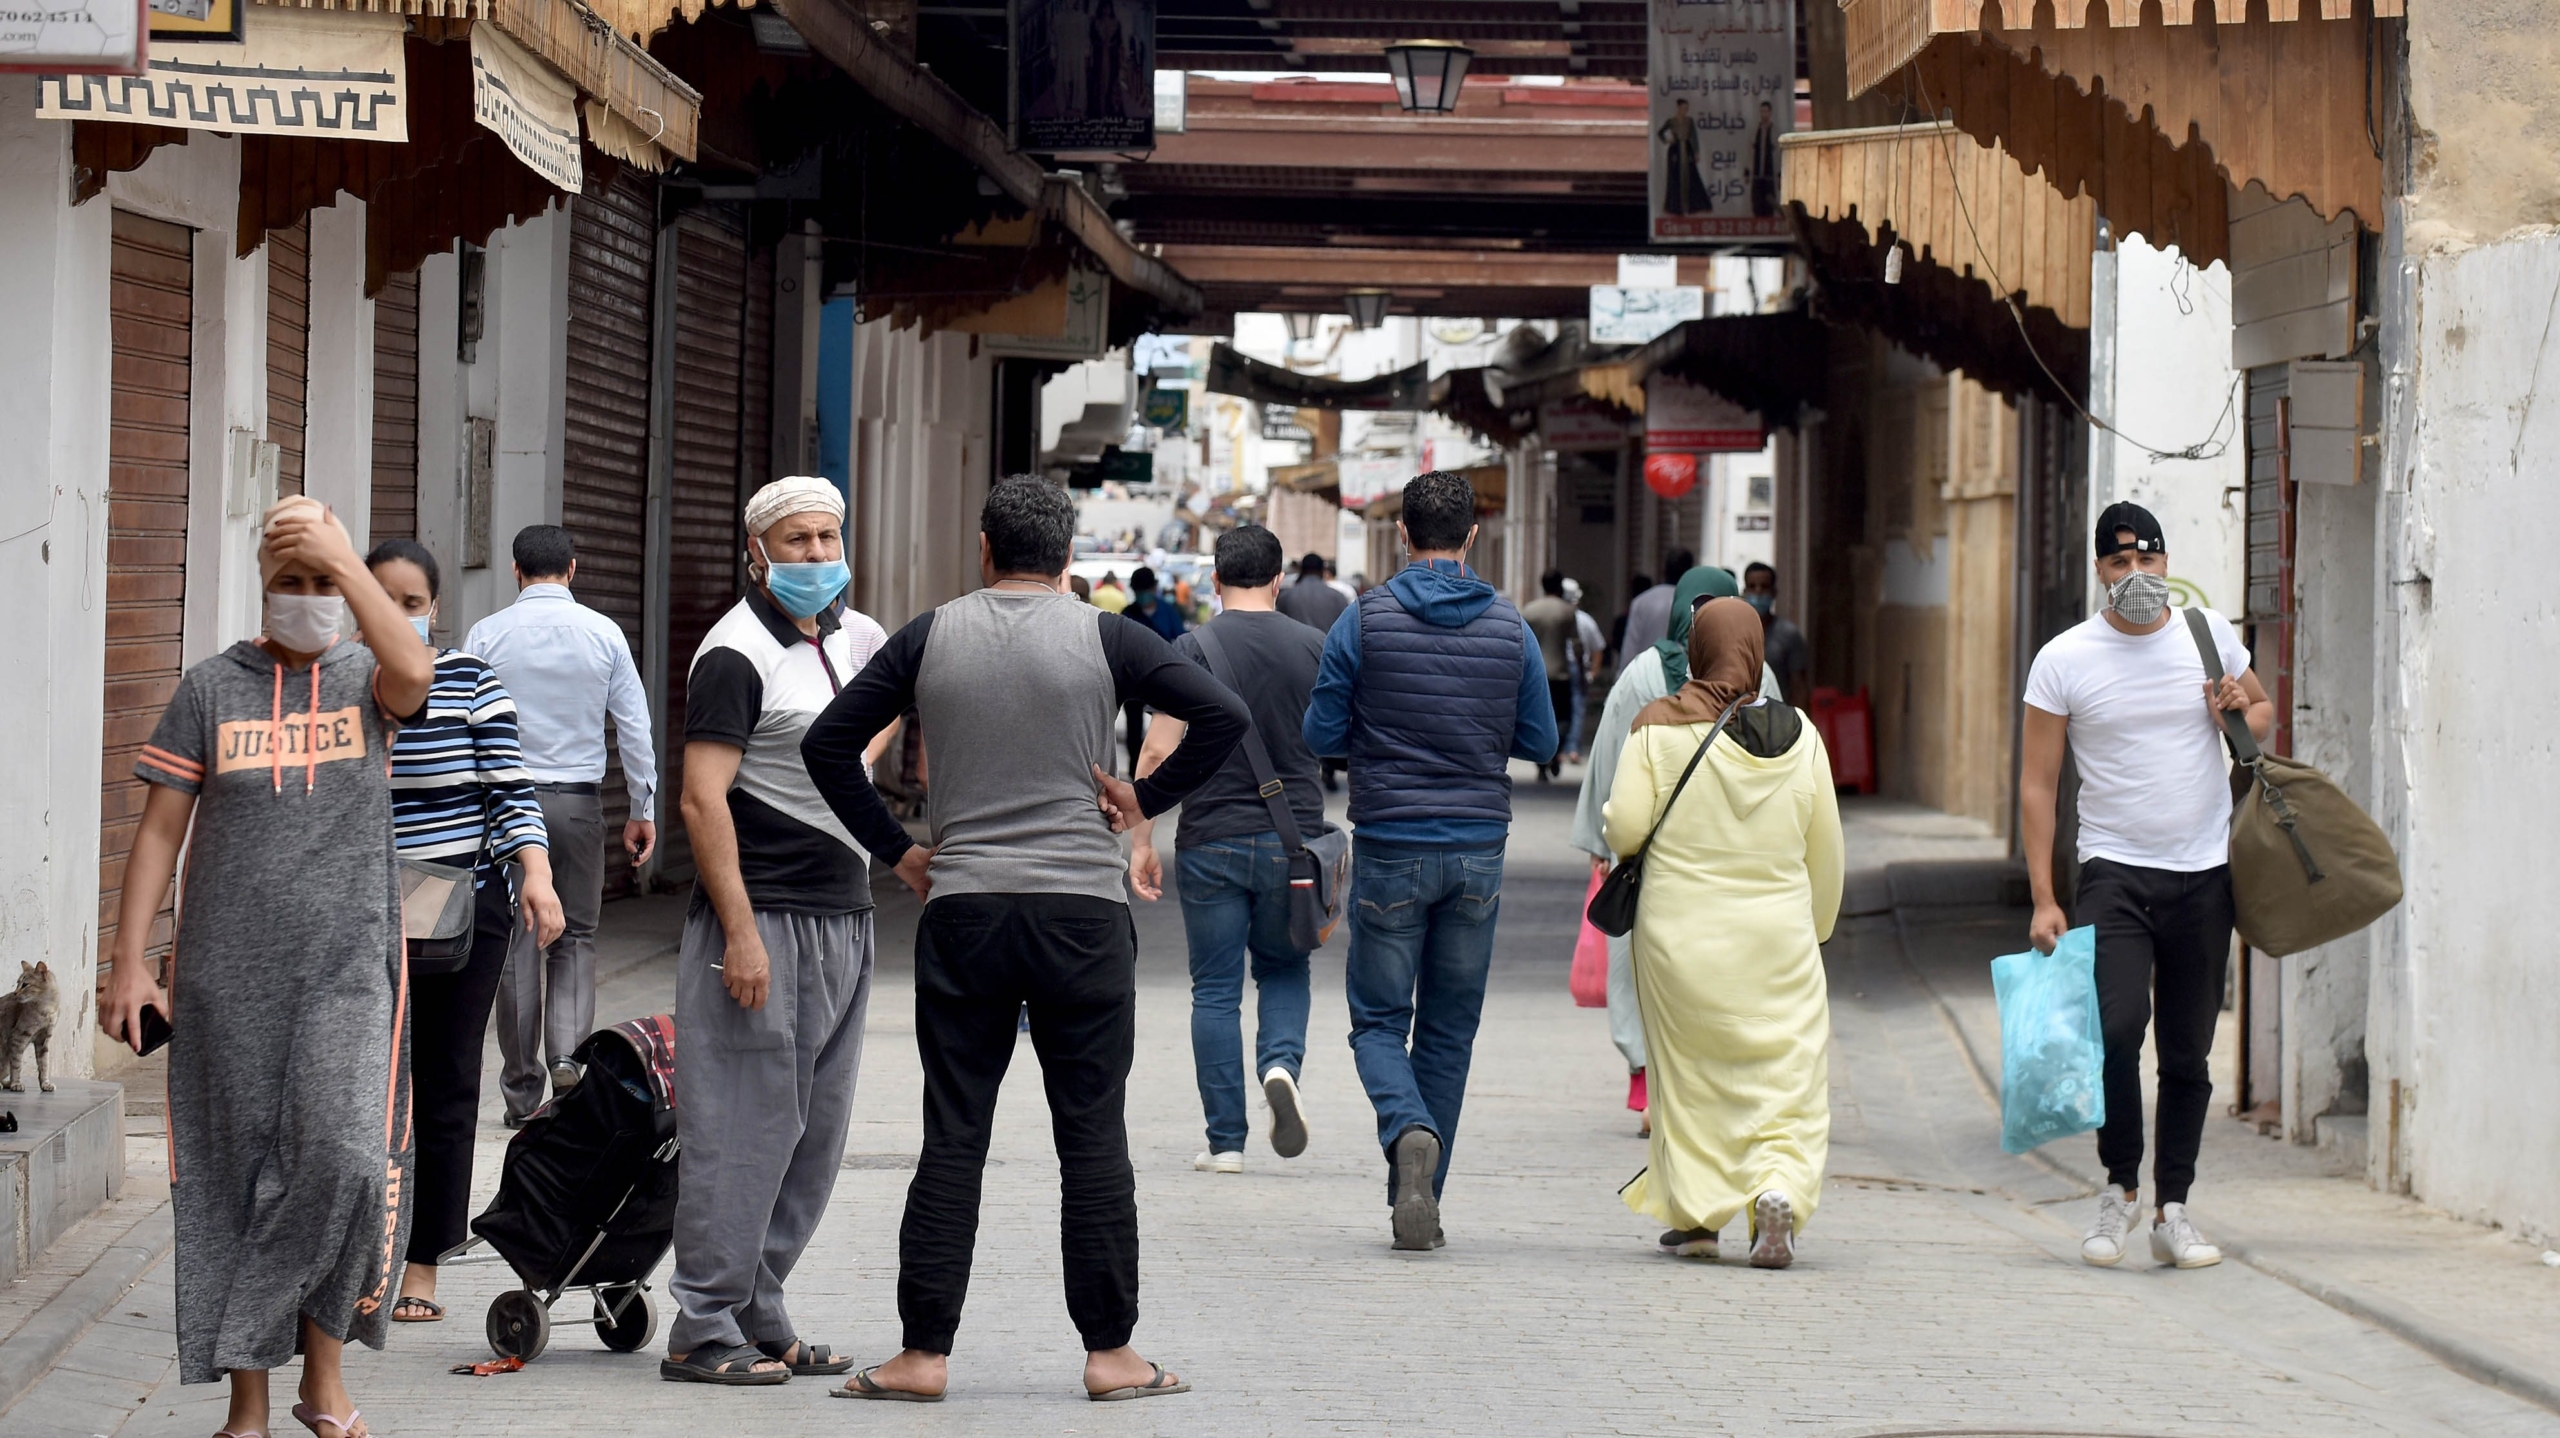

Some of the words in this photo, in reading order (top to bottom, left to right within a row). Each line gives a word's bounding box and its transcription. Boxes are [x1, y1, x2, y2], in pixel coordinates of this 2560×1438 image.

[1697, 111, 1746, 134] خياطة
[1710, 151, 1737, 171] بيع
[353, 1158, 403, 1316] JUSTICE
